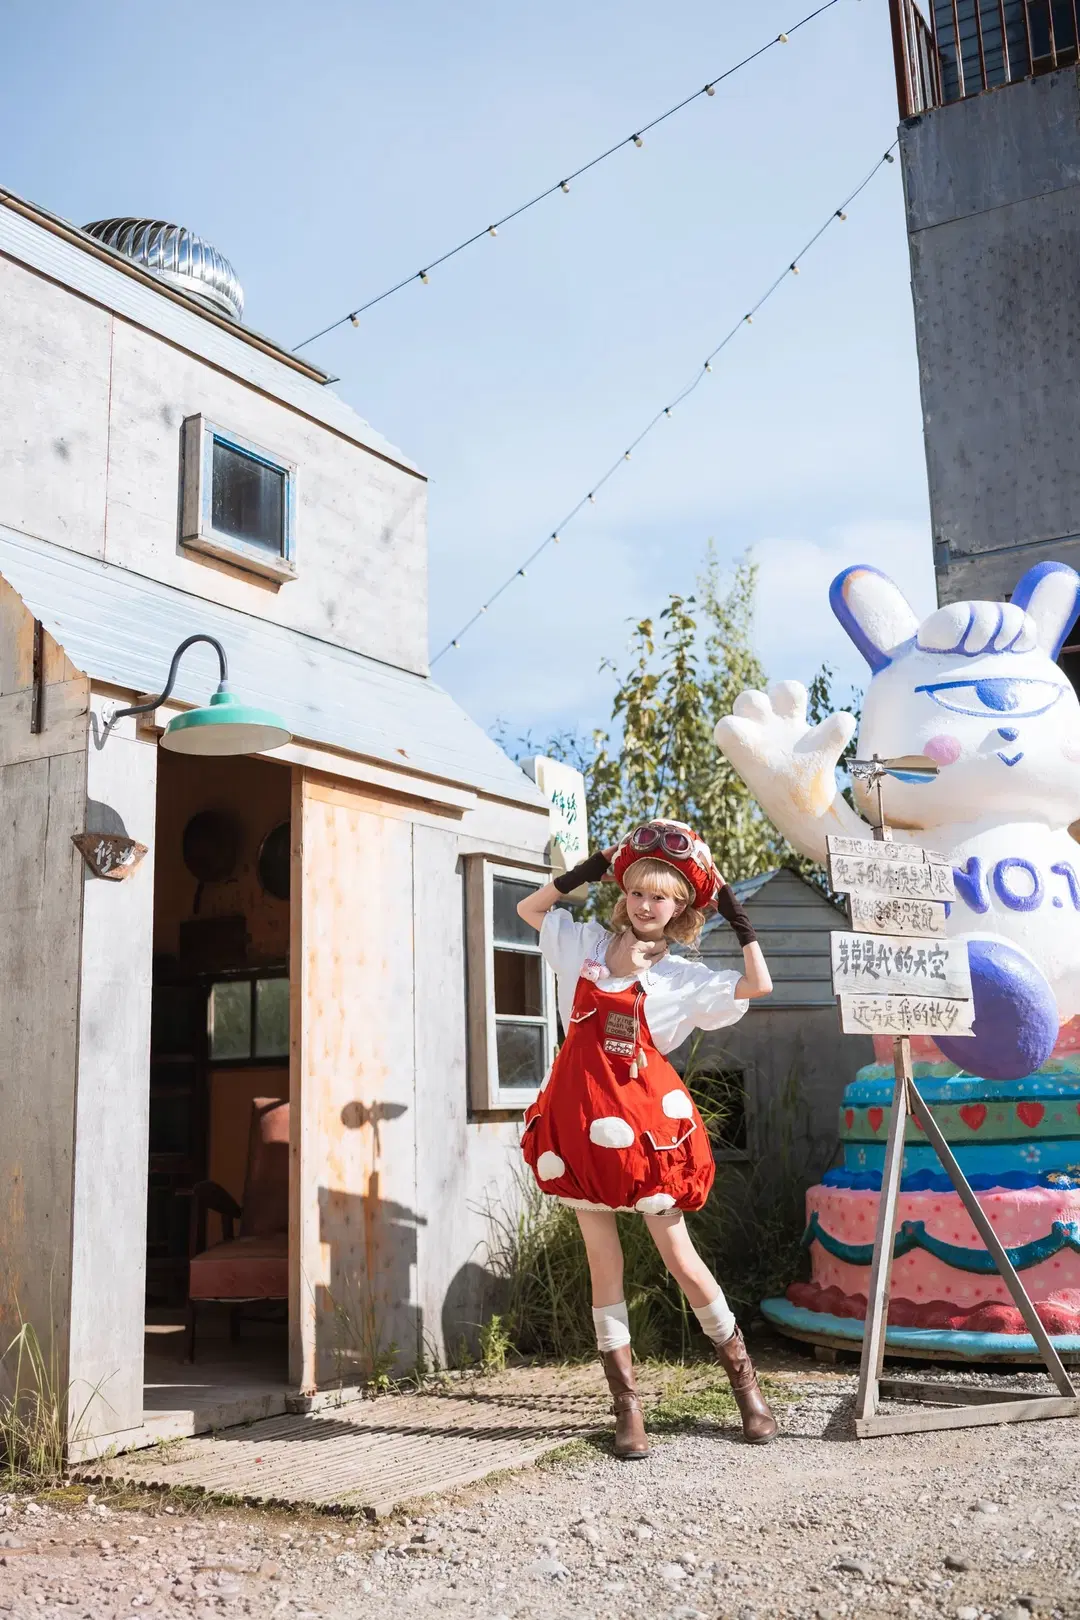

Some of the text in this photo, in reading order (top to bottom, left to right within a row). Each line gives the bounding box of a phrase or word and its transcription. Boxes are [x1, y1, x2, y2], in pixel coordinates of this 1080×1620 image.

[852, 998, 959, 1031] 远方是我的故乡
